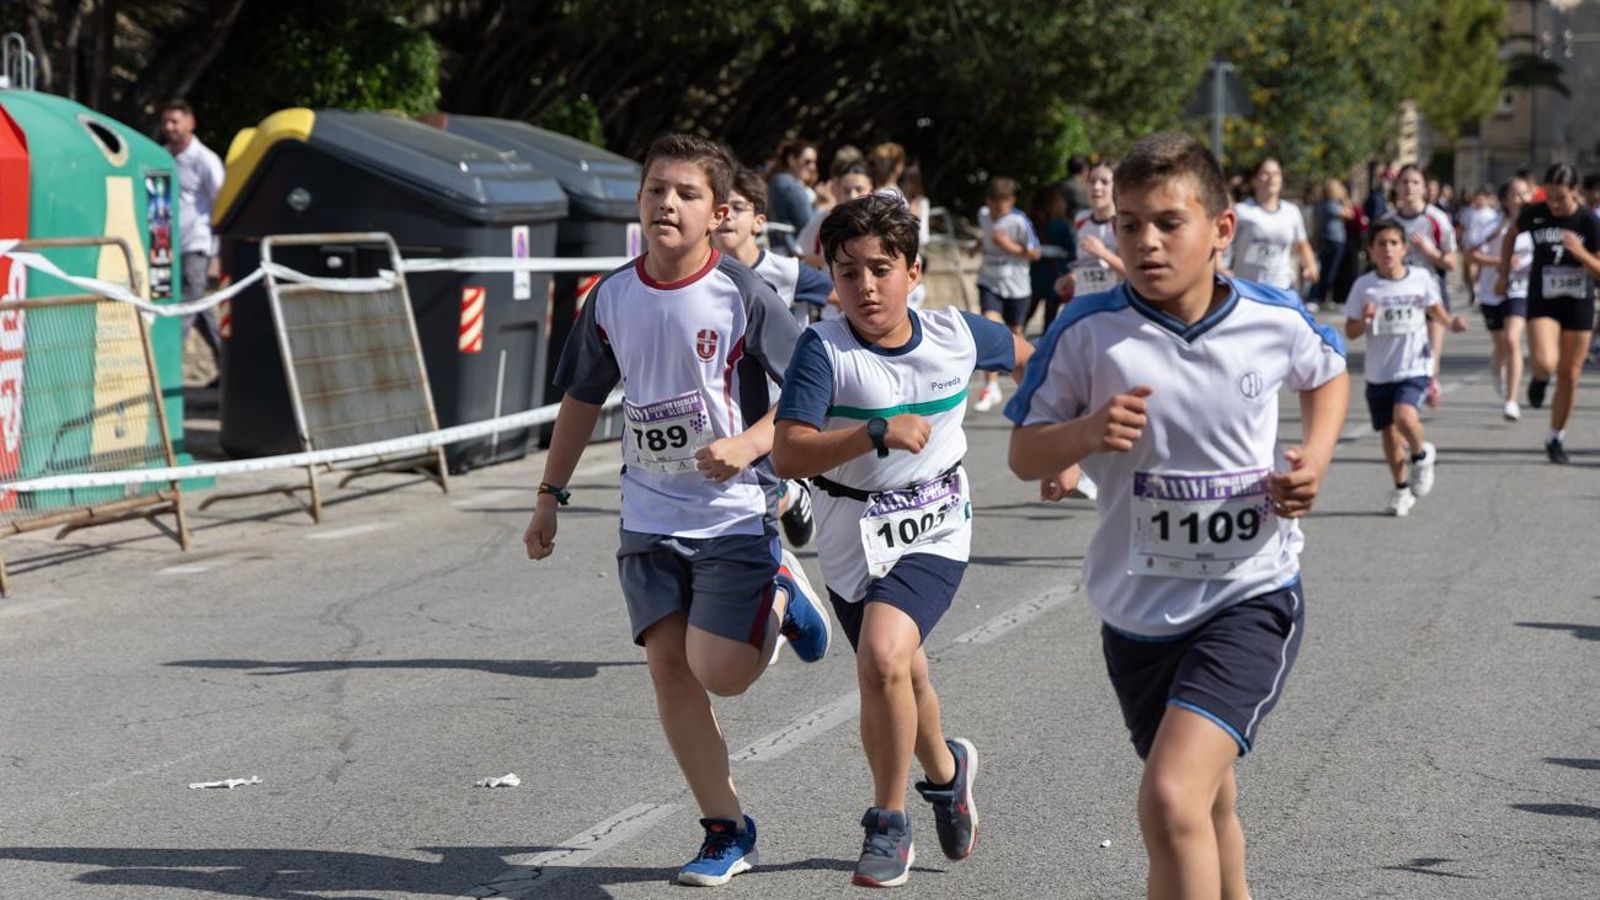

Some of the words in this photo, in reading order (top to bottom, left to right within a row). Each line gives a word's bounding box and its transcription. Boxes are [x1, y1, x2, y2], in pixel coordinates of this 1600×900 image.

[1551, 244, 1564, 265] 7
[1384, 308, 1413, 322] 611
[931, 376, 961, 392] Poveda
[632, 425, 688, 452] 789
[1151, 509, 1260, 544] 1109
